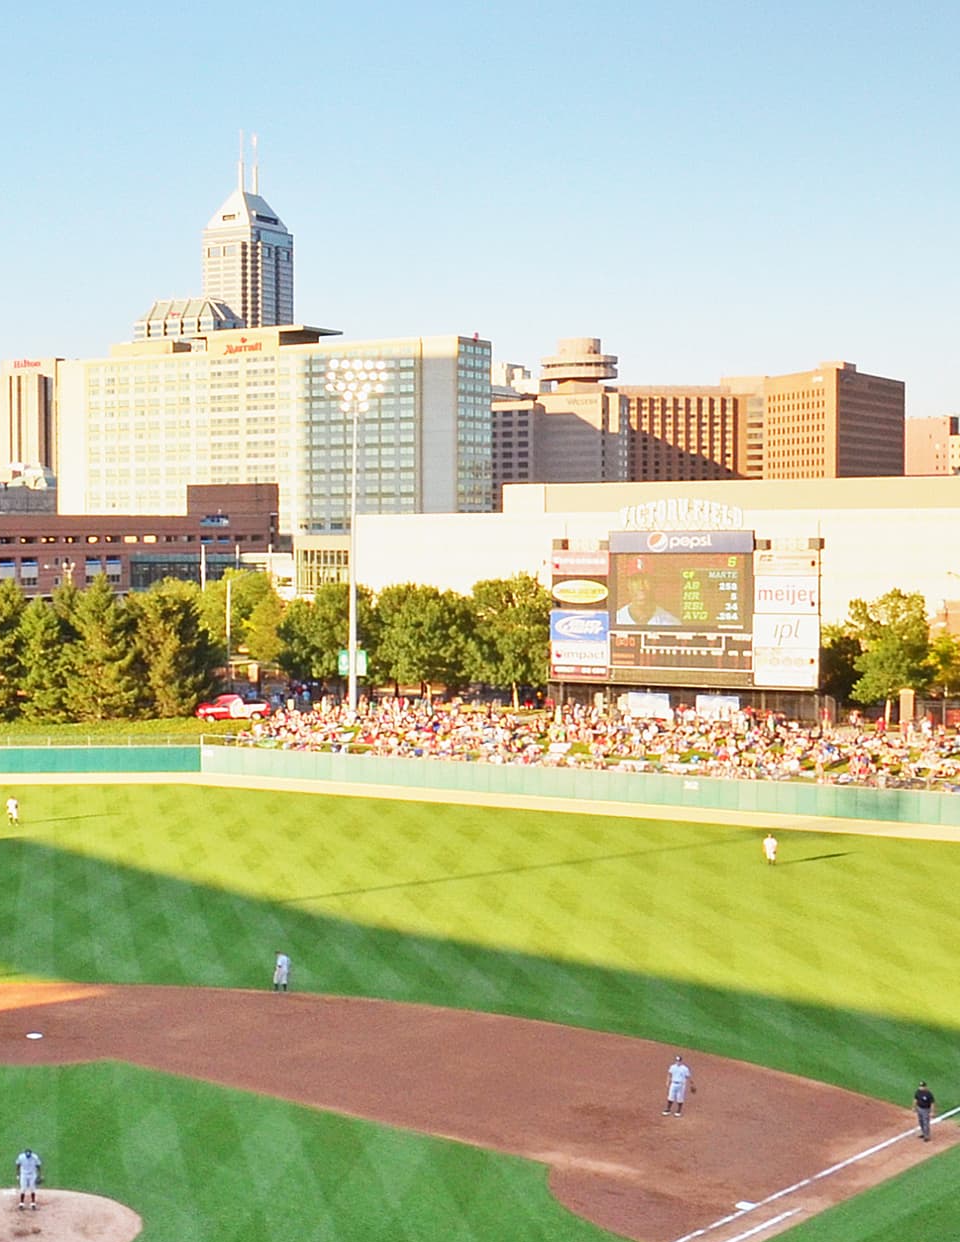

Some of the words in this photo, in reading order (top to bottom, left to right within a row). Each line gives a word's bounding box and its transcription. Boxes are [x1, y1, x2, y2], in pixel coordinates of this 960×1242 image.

[619, 497, 689, 530] VICTORY
[692, 498, 744, 530] FIELD
[669, 534, 713, 549] pepsi
[758, 585, 816, 606] meijer
